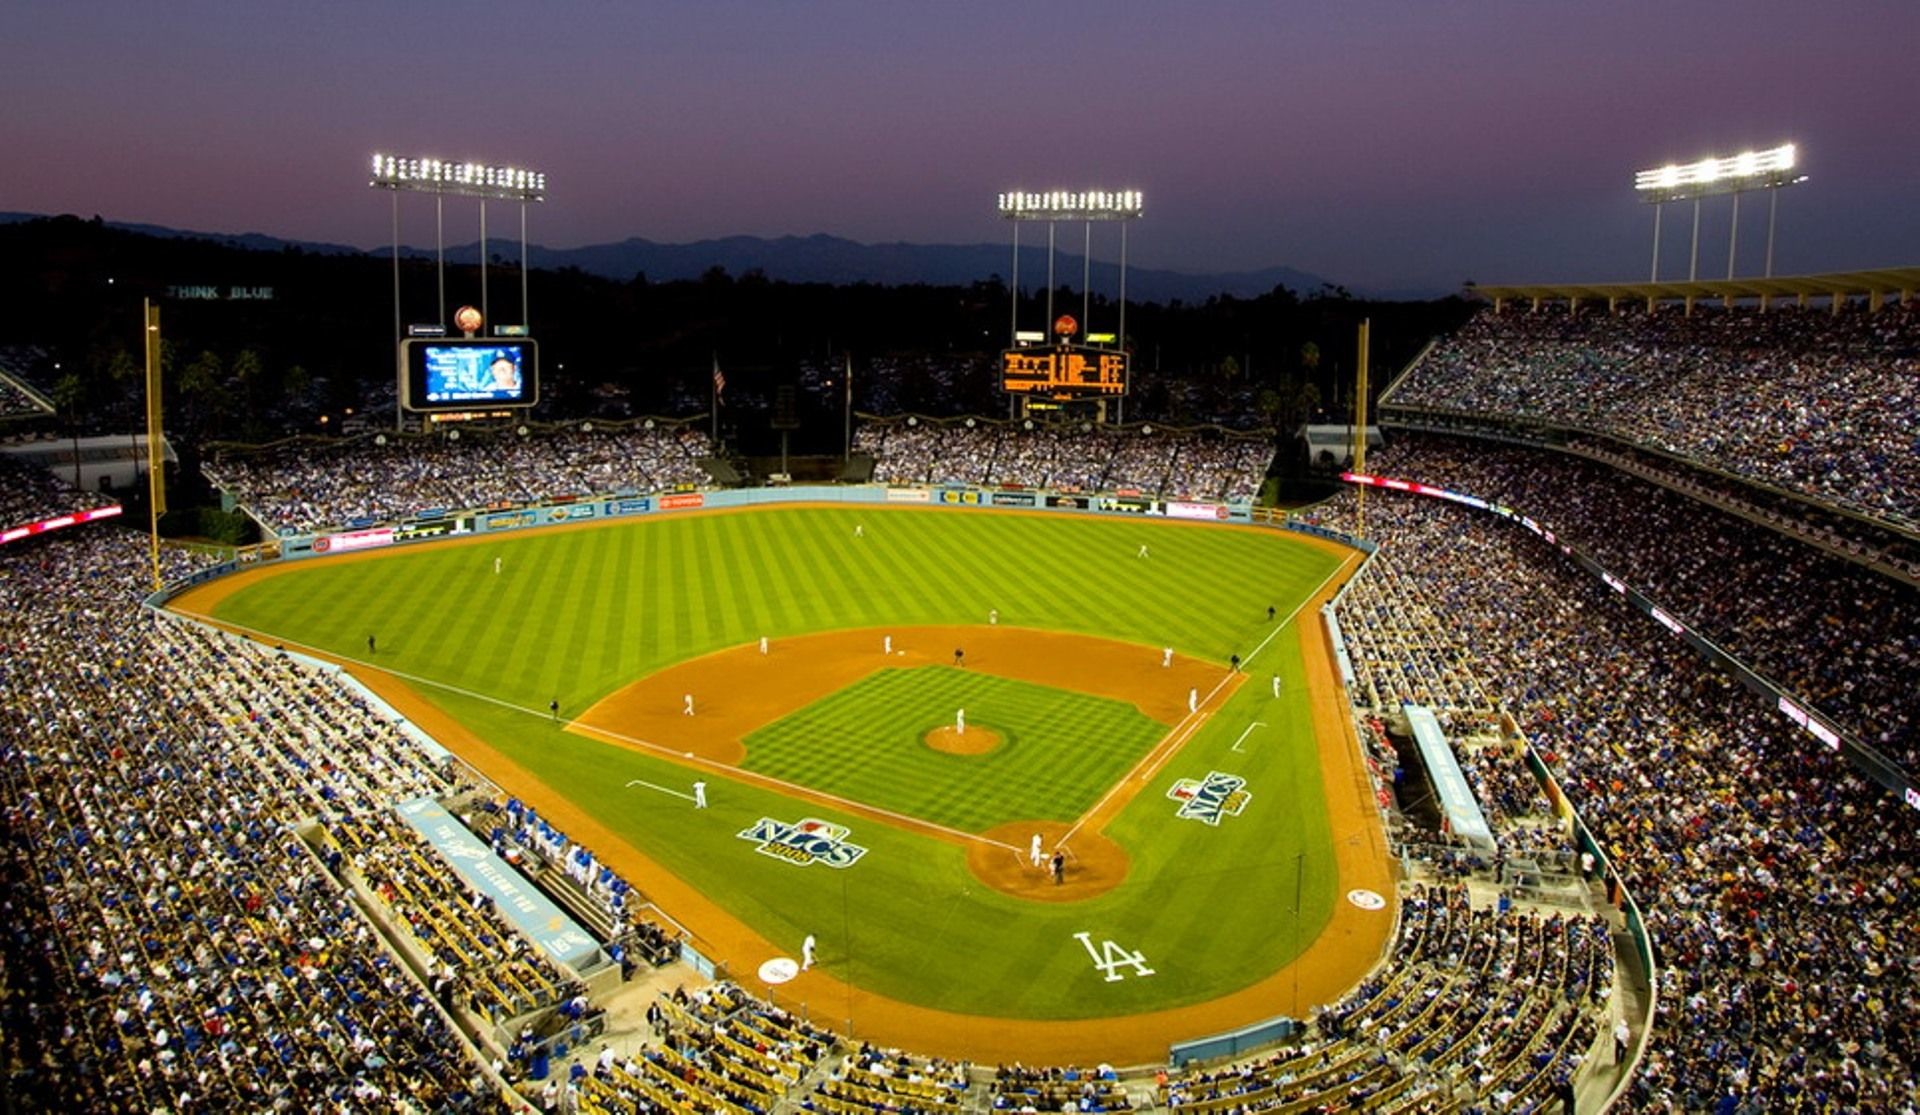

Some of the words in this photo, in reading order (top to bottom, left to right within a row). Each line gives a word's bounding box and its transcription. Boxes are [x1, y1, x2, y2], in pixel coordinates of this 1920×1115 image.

[164, 286, 219, 299] THINK
[231, 286, 274, 299] BLUE
[741, 819, 864, 867] NLCS
[765, 842, 814, 862] 2008
[1072, 931, 1156, 982] LA
